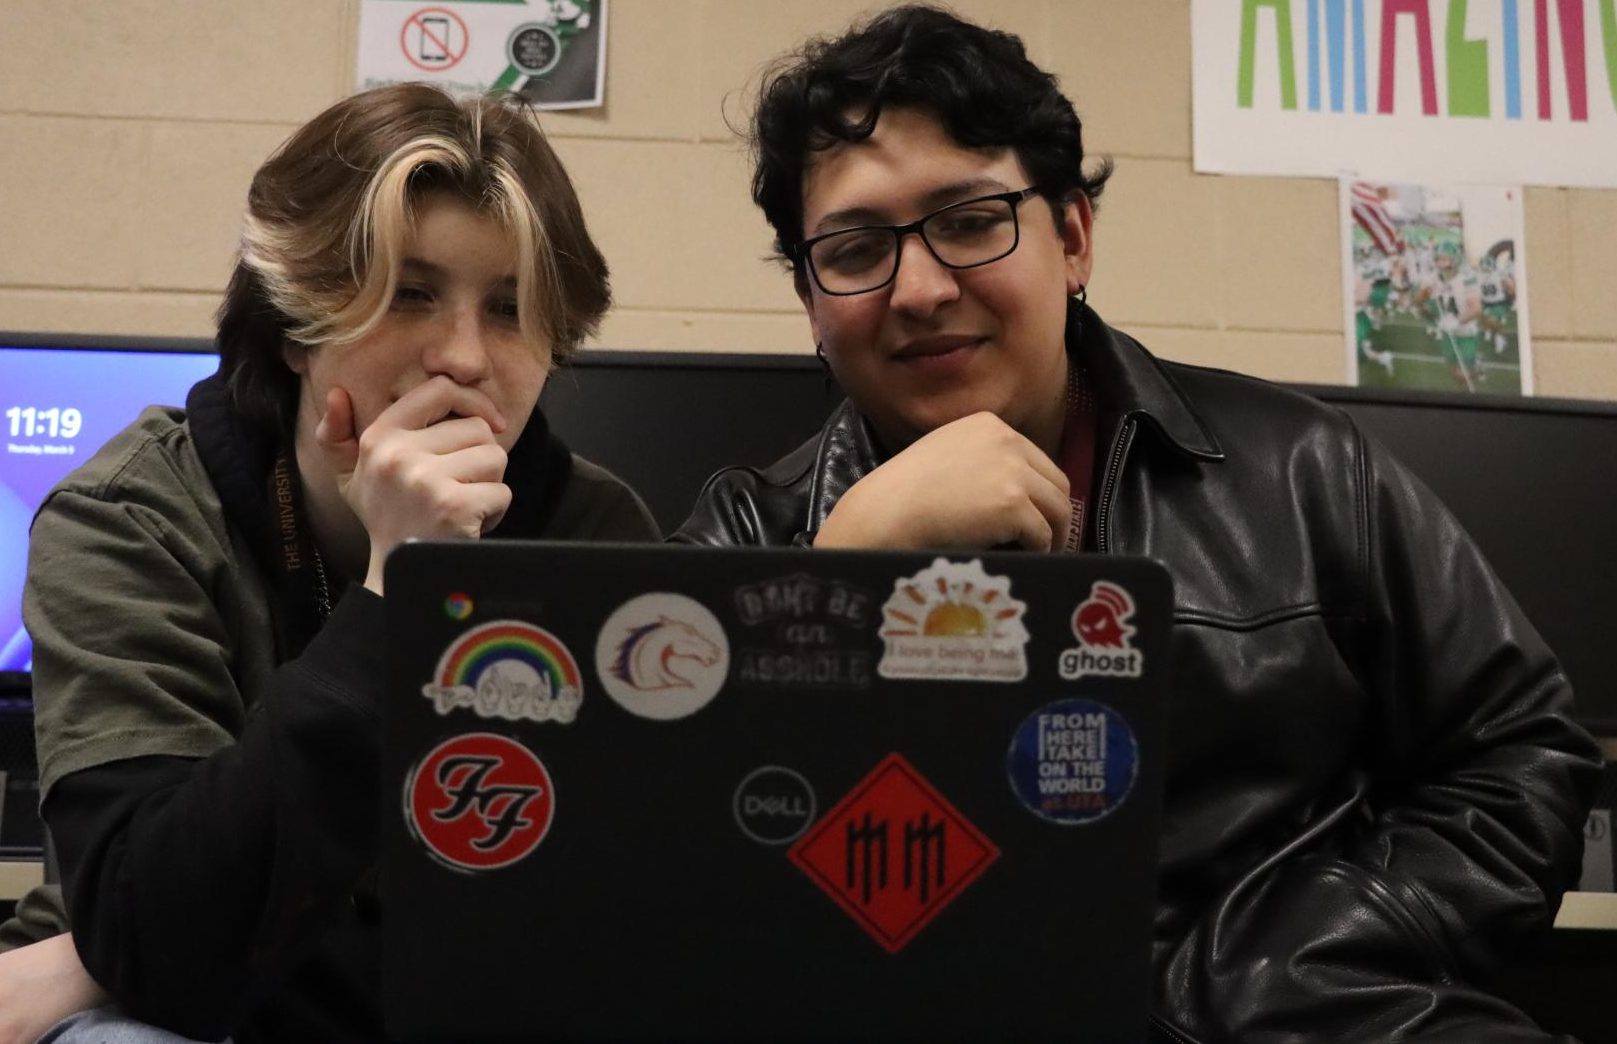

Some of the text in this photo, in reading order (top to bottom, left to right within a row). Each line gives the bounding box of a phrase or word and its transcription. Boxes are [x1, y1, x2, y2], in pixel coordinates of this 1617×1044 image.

[6, 406, 82, 439] 11:19
[274, 453, 301, 572] THE UNIVERSITY
[942, 645, 985, 664] being
[1063, 650, 1137, 675] ghost
[1038, 713, 1106, 730] FROM
[1046, 729, 1098, 746] HERE
[1046, 744, 1098, 761] TAKE
[1038, 760, 1105, 778] ON THE
[1038, 777, 1105, 794] WORLD
[745, 795, 807, 815] DELL
